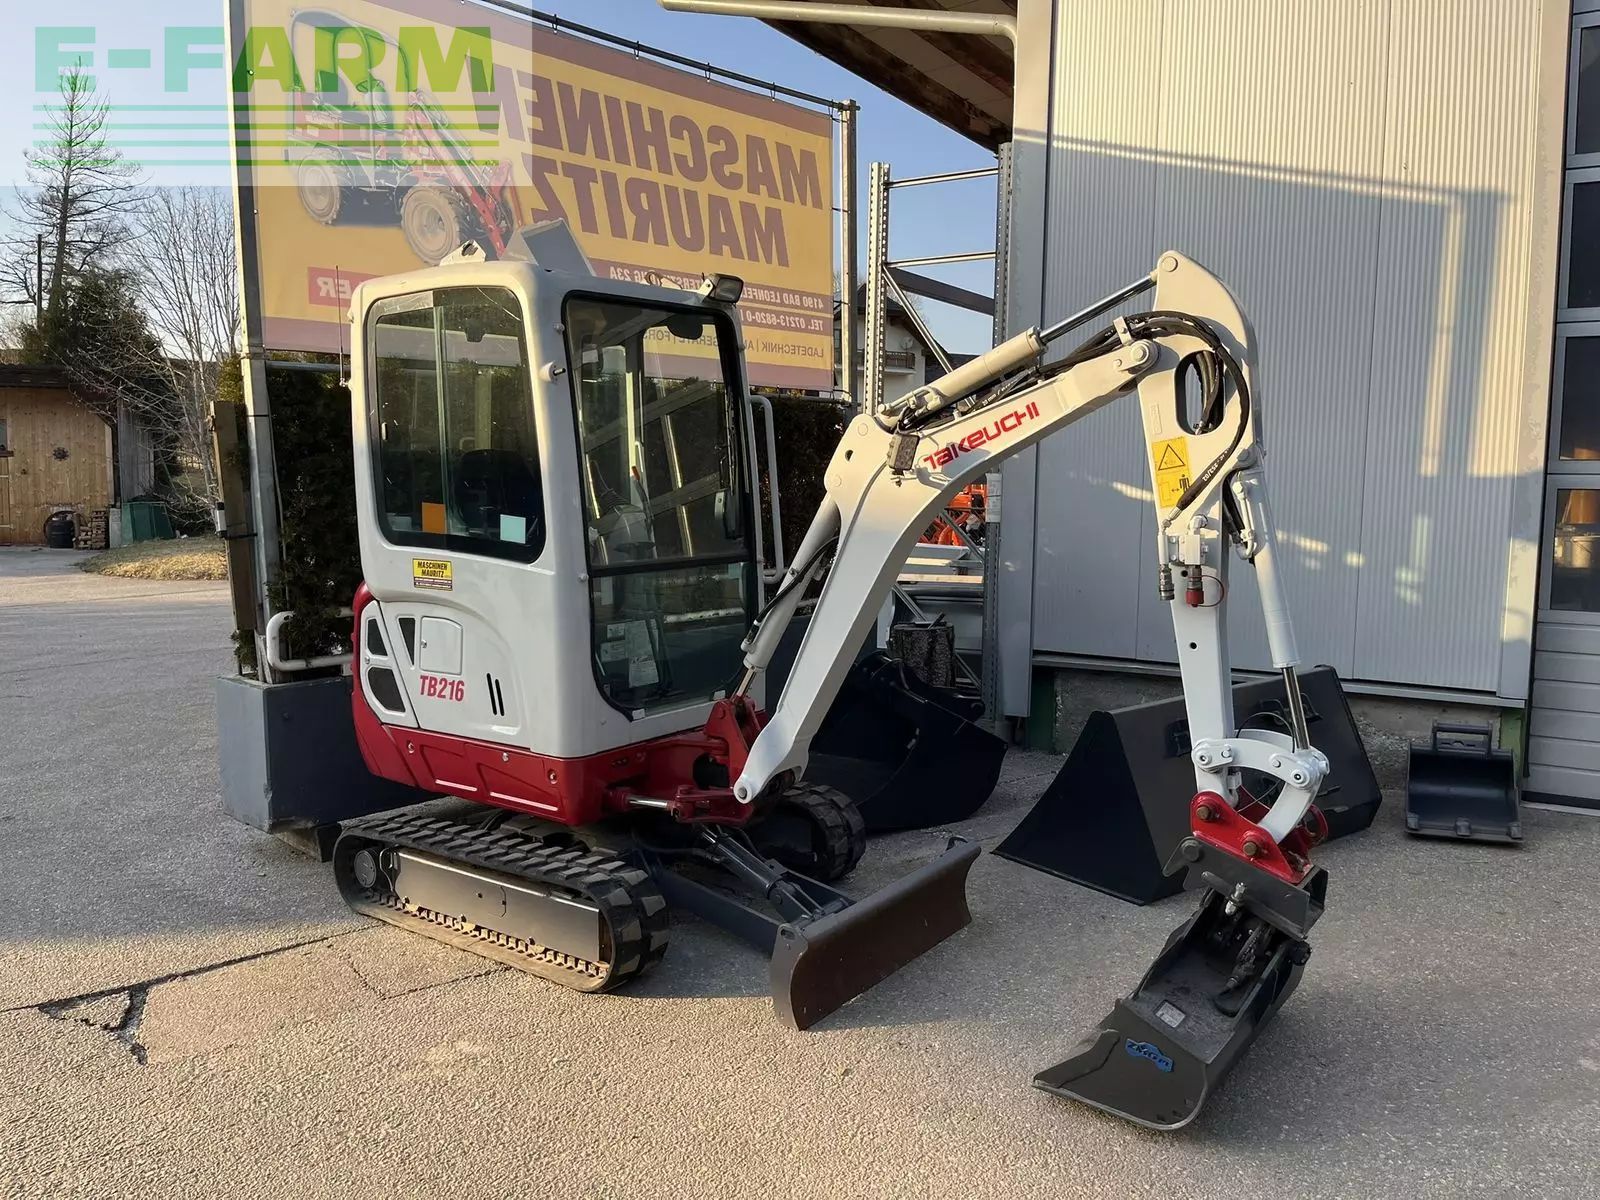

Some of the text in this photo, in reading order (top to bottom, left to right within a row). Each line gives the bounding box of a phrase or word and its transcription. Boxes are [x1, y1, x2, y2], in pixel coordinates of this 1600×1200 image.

[417, 561, 448, 571] MASCHINEN
[421, 569, 445, 578] MAURITZ
[420, 675, 465, 702] TB216
